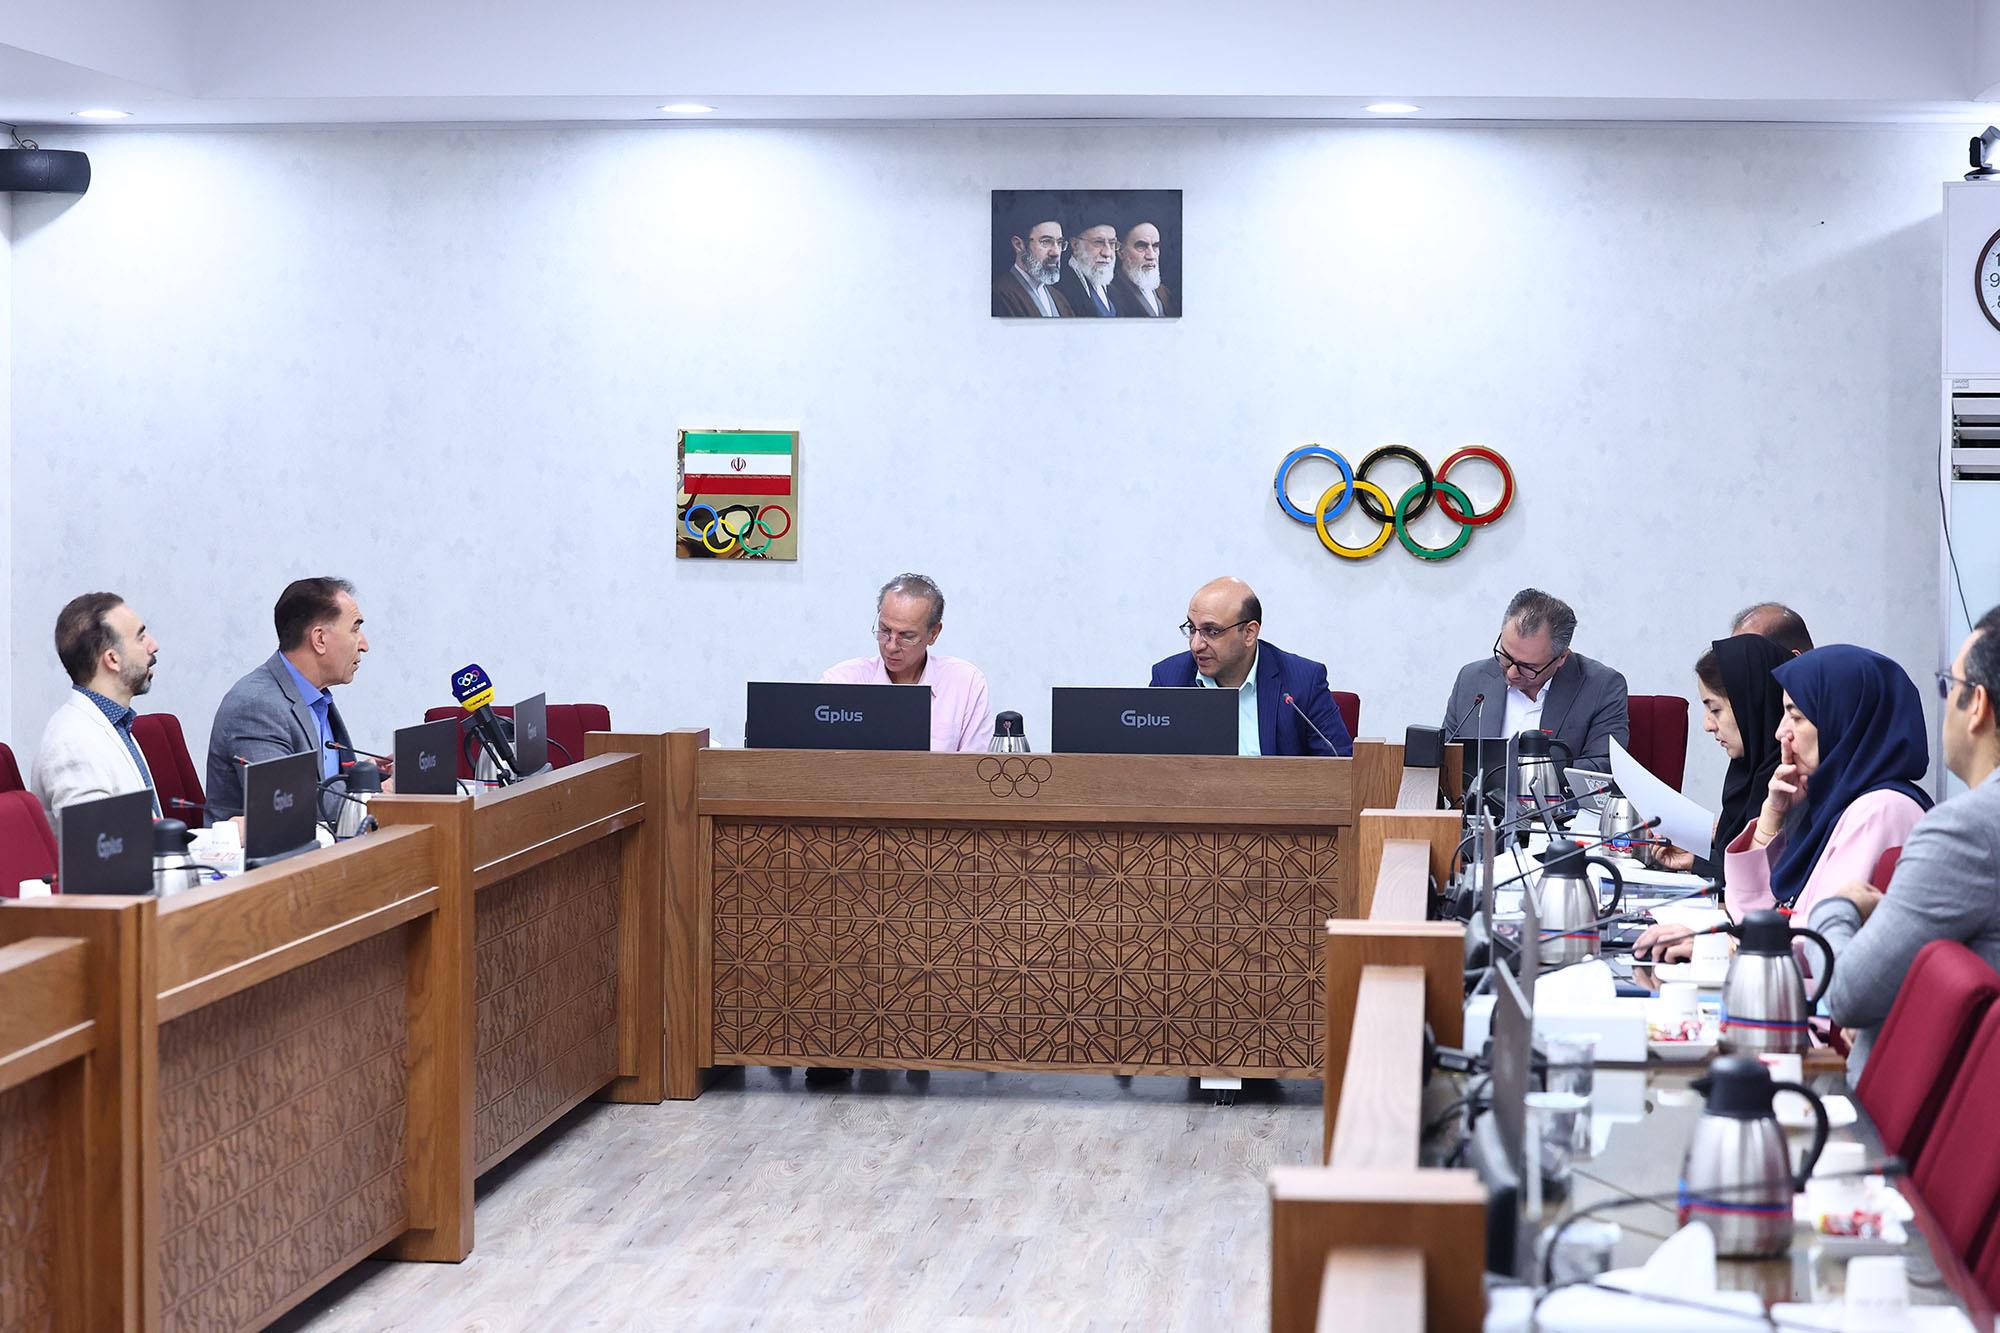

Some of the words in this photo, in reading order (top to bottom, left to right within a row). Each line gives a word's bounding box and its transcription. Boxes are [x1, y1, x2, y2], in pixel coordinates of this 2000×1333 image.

[1990, 272, 2000, 287] 9
[814, 705, 863, 724] Gplus
[1121, 709, 1170, 728] Gplus
